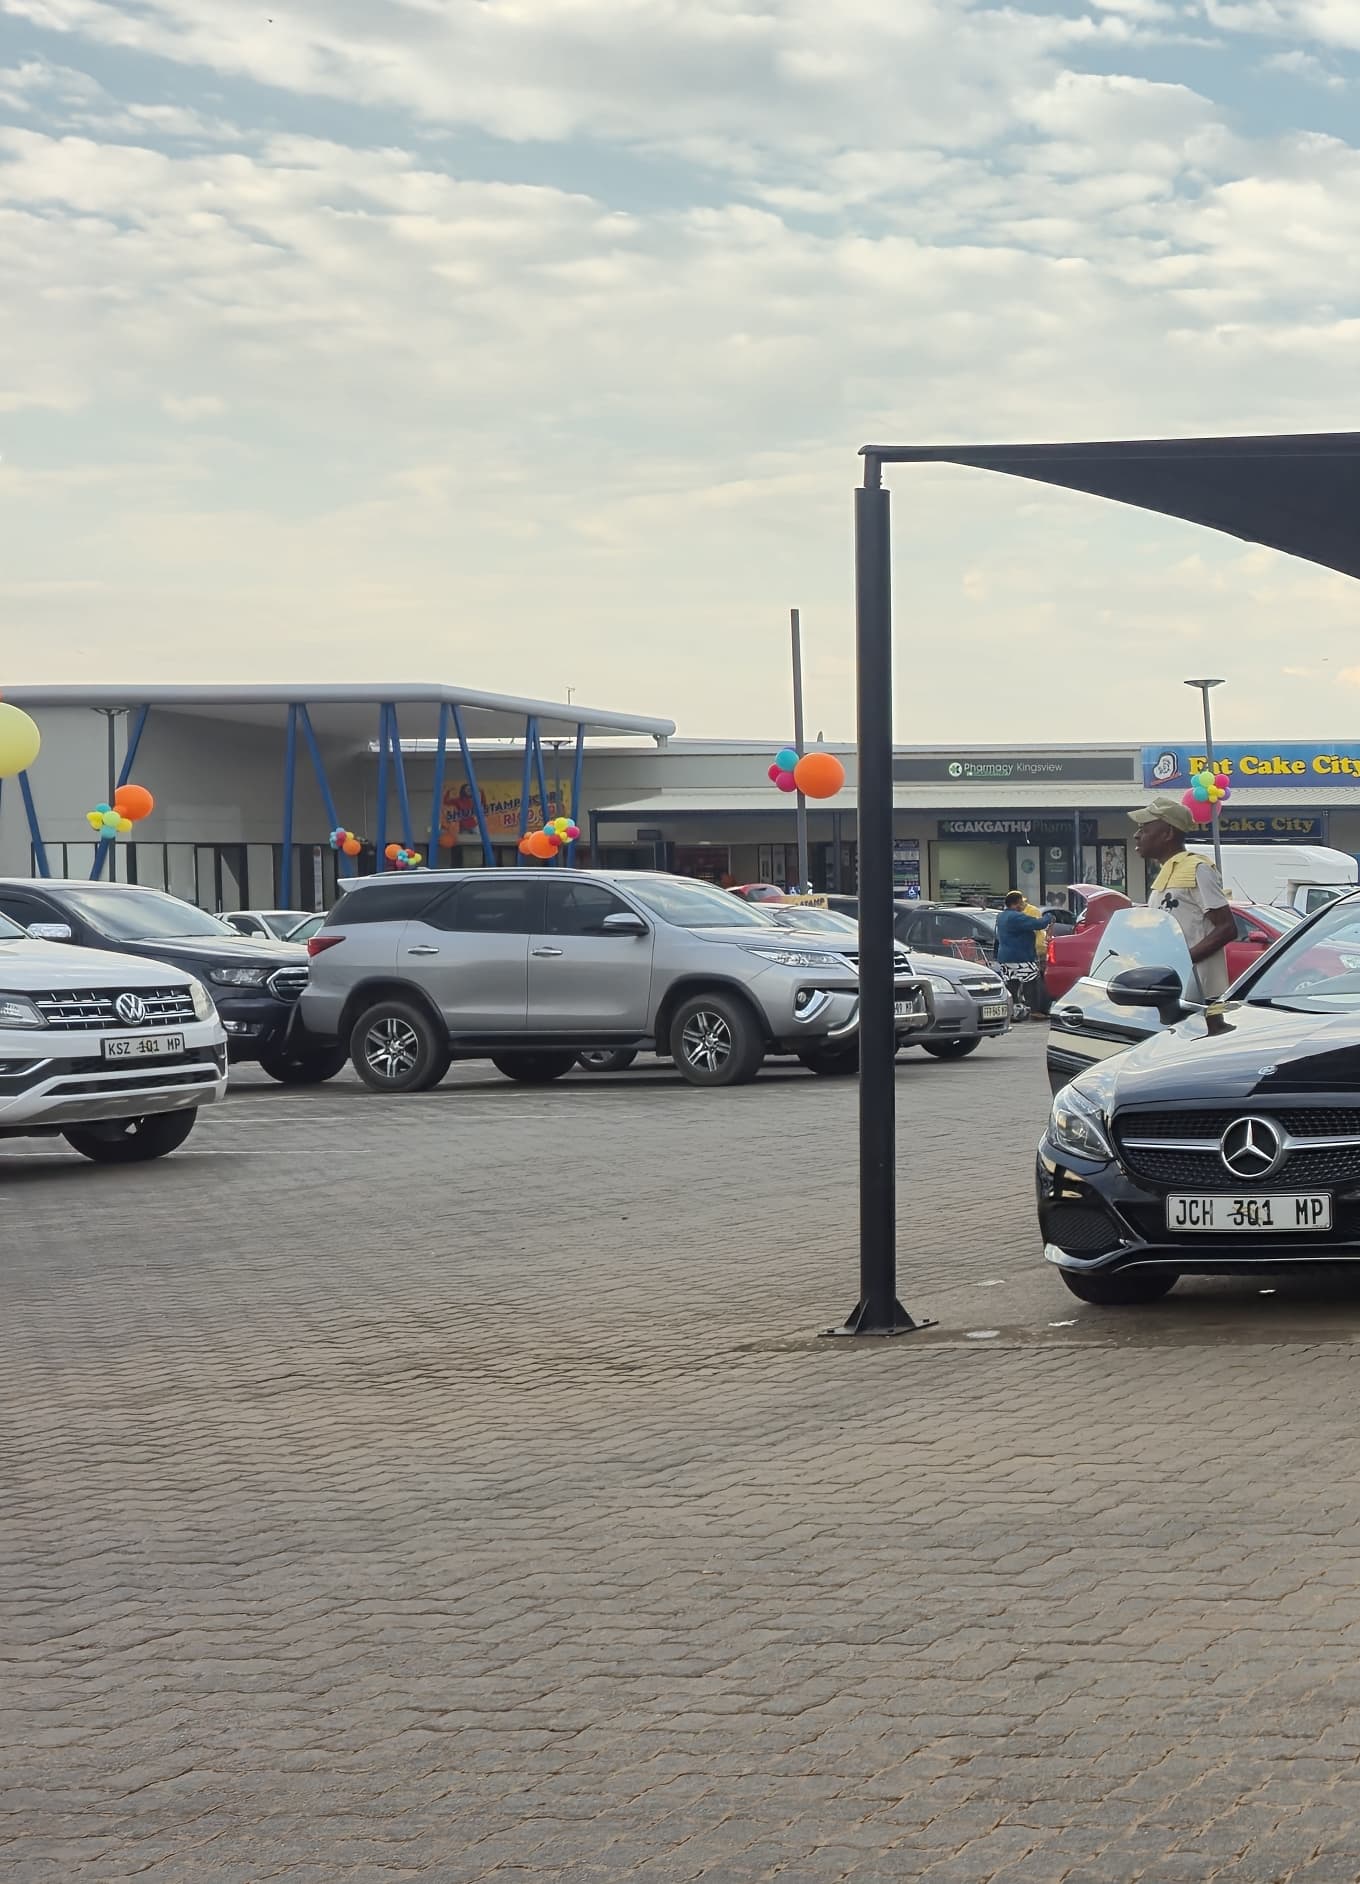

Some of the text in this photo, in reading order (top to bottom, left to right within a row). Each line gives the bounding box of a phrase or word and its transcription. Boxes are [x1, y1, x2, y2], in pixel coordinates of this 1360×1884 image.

[964, 762, 1014, 776] Pharmacy
[1016, 763, 1063, 773] Kingsview
[1239, 756, 1306, 775] Cake
[1219, 817, 1265, 832] Cake
[1271, 817, 1314, 833] City
[108, 1043, 131, 1055] KSZ
[167, 1038, 180, 1050] MP
[1176, 1200, 1214, 1226] JCH
[1296, 1199, 1323, 1225] MP
